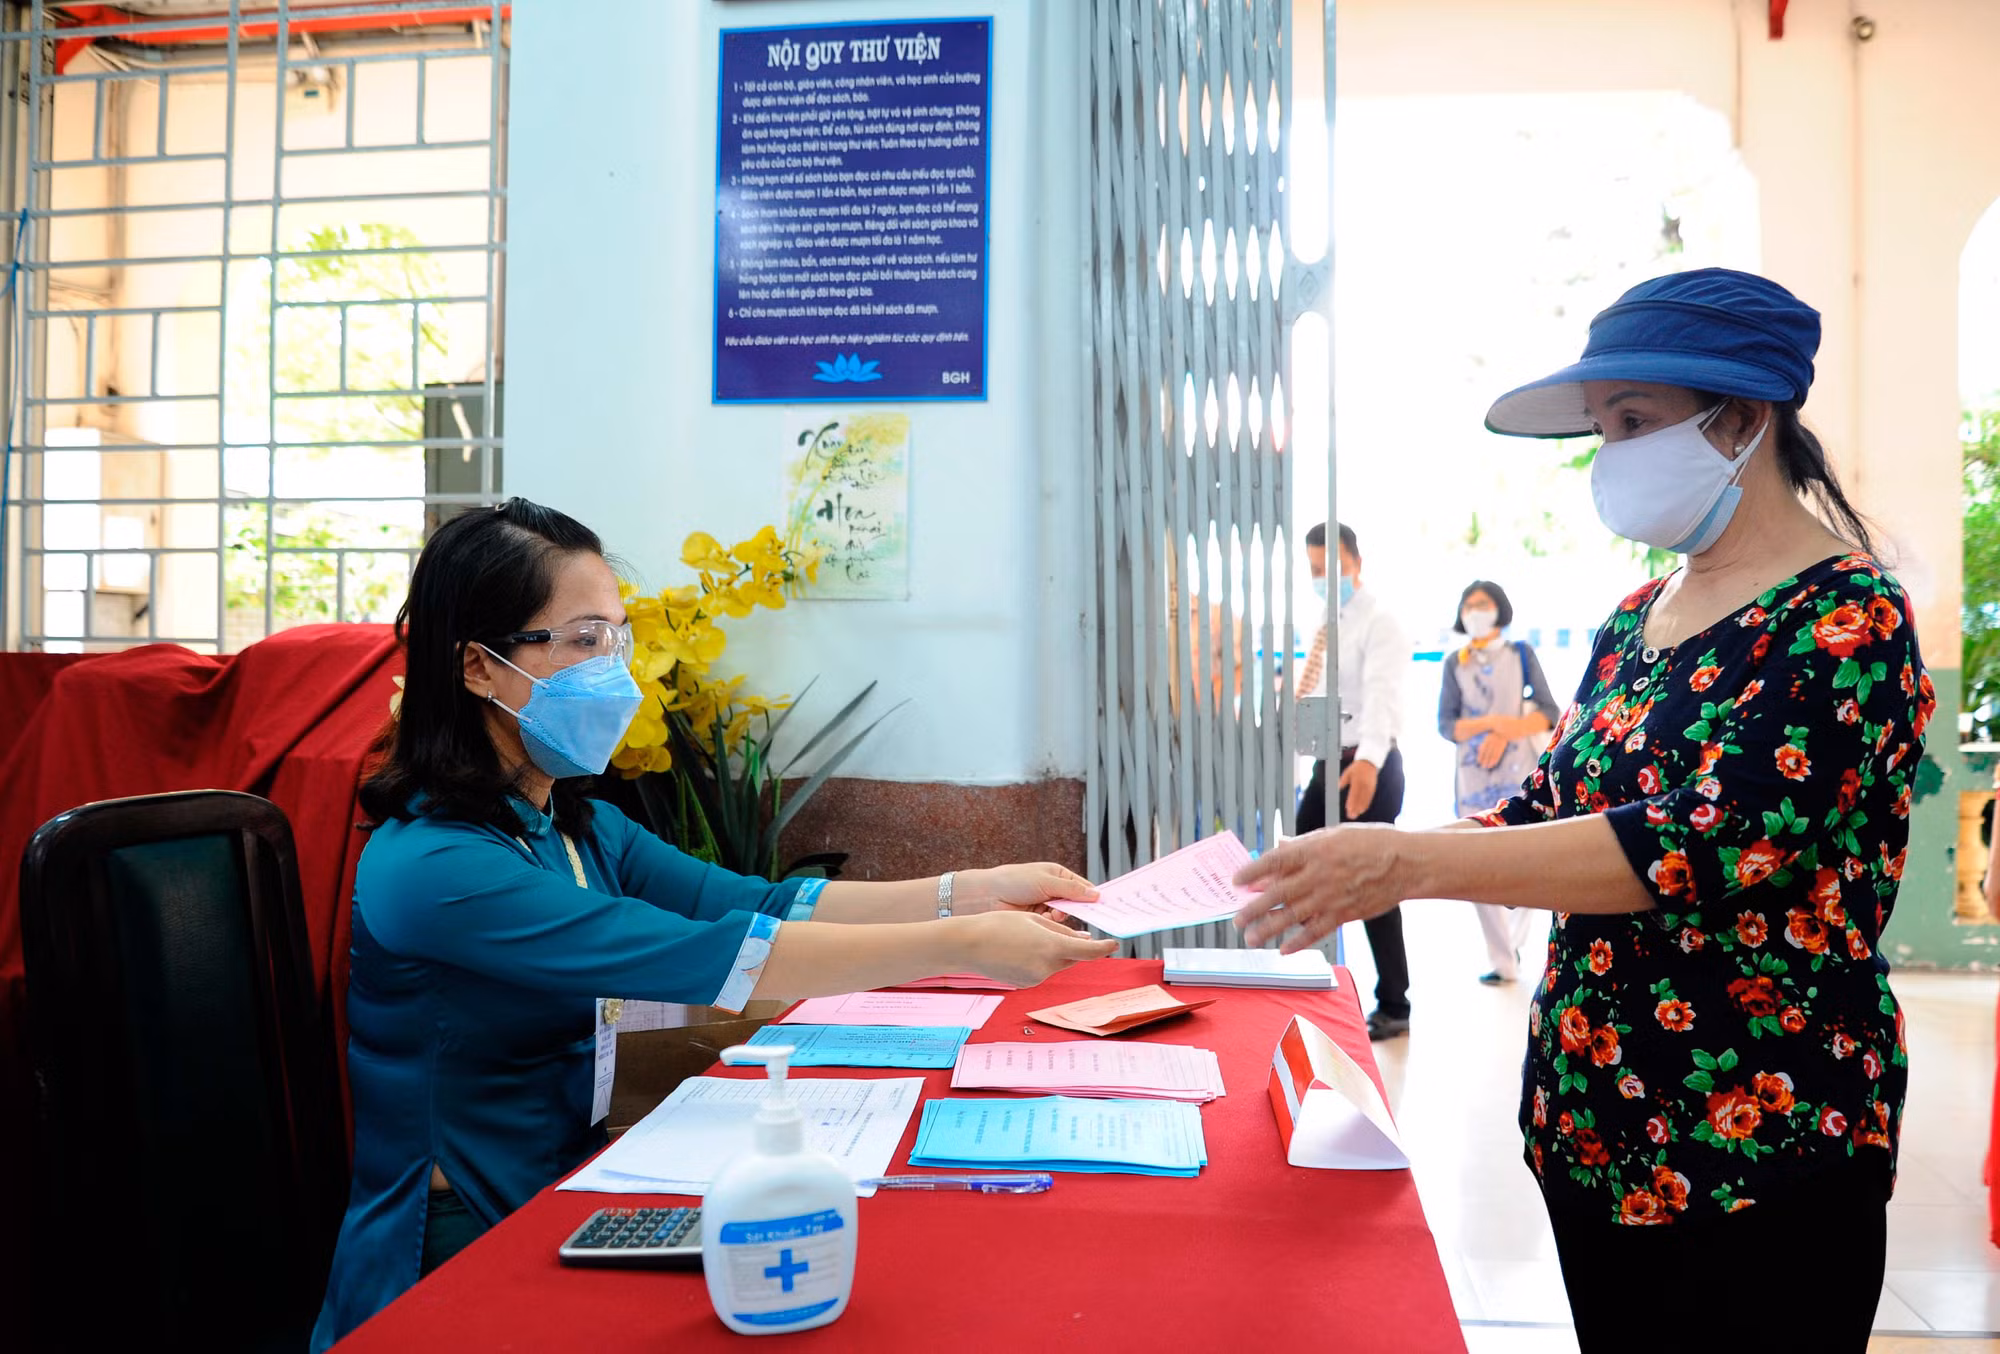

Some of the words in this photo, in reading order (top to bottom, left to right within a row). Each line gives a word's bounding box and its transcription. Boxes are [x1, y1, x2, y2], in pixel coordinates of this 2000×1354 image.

[767, 37, 800, 72] NỘI
[805, 40, 844, 70] QUY
[848, 35, 890, 63] THƯ
[893, 31, 941, 66] VIỆN
[942, 372, 970, 384] BGH
